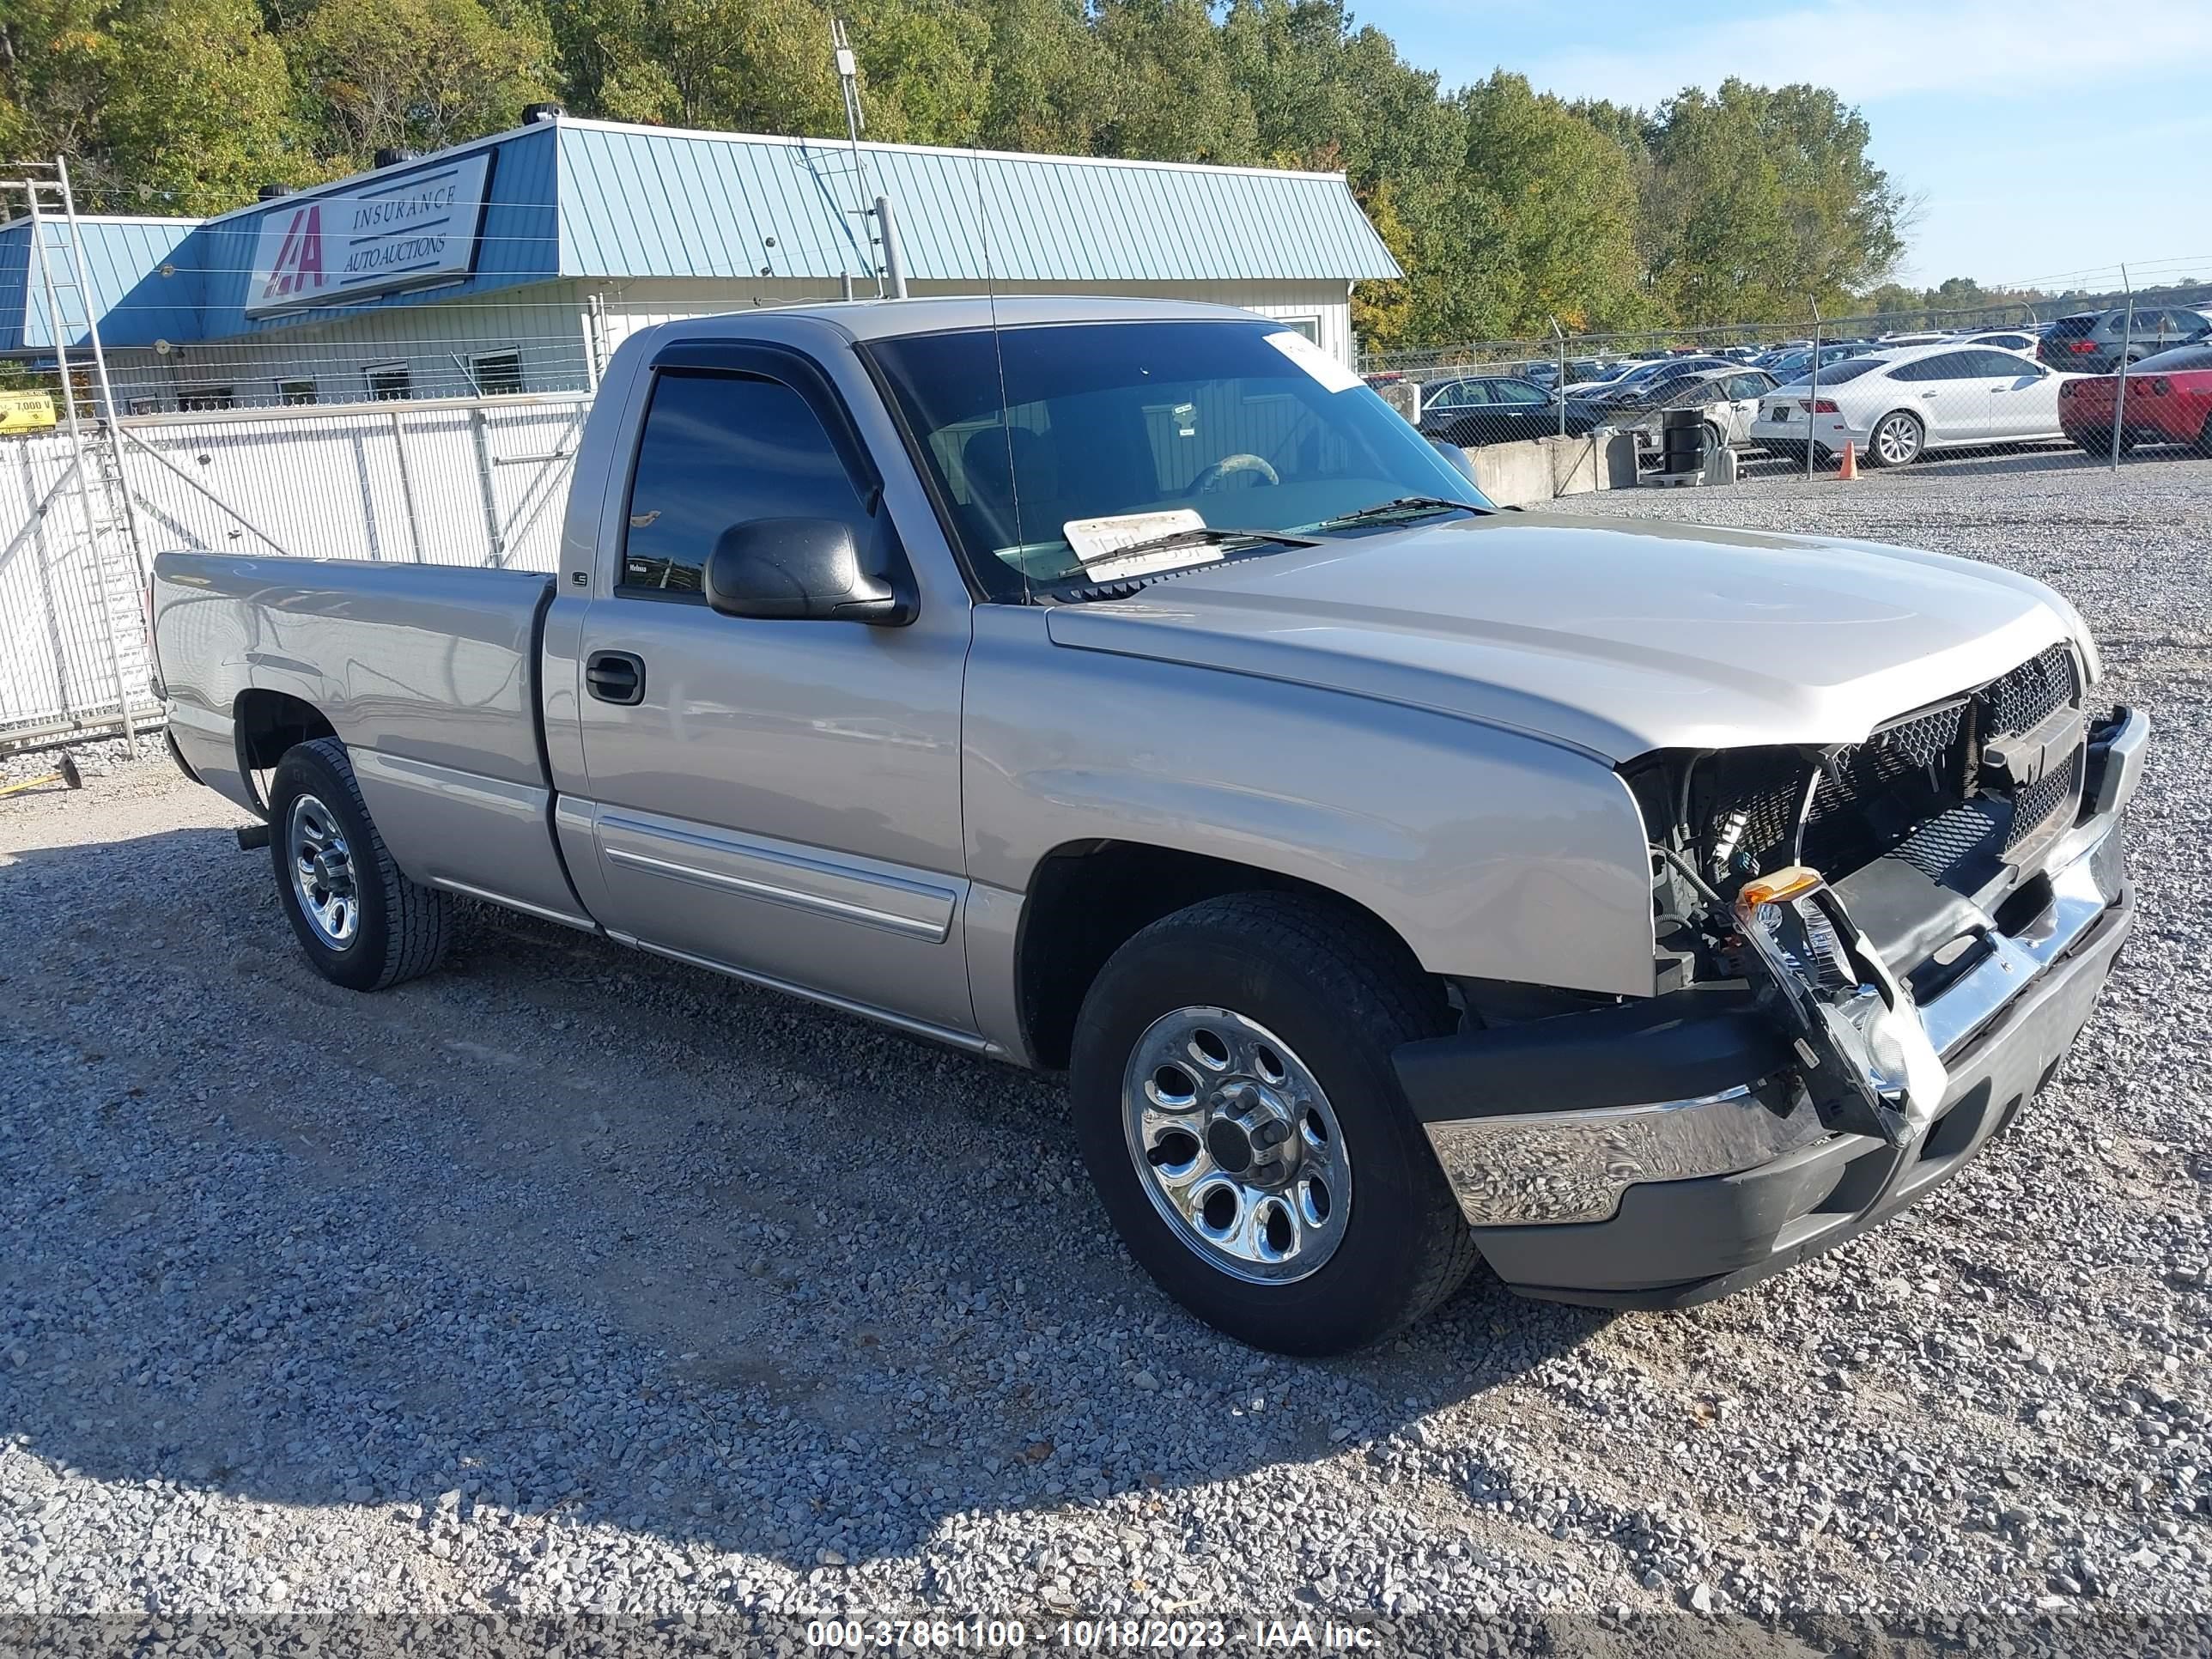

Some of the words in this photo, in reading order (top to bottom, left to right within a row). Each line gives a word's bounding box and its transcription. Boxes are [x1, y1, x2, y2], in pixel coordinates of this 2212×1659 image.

[353, 185, 455, 229] INSURANCE
[343, 248, 380, 272] AUTO
[379, 234, 447, 265] AUCTIONS
[15, 401, 42, 412] 7,000
[44, 400, 51, 409] V
